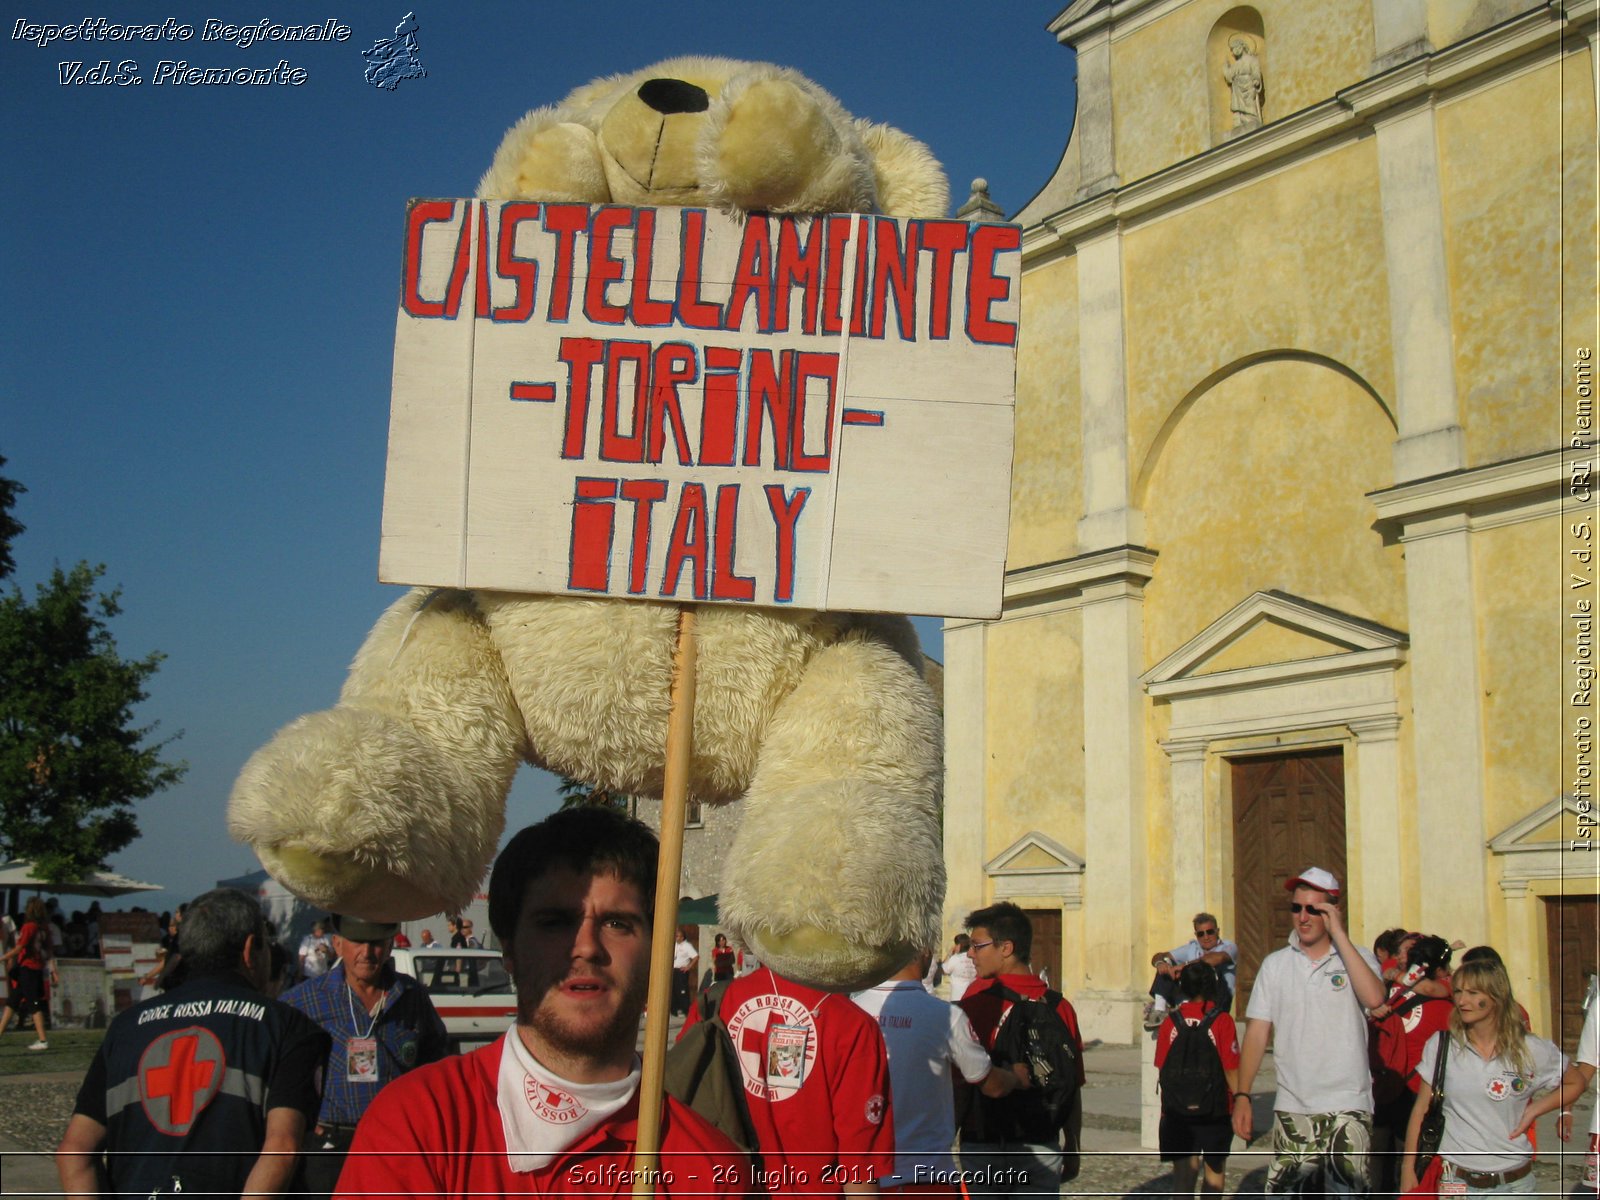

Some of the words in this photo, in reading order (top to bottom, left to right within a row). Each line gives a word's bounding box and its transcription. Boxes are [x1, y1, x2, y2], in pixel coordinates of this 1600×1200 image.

[401, 200, 1023, 346] CASTELLAMONTE
[138, 1004, 173, 1025] CROCE
[173, 1000, 212, 1018] ROSSA
[214, 999, 266, 1021] ITALIANA
[756, 996, 793, 1010] ROSSA
[535, 1102, 578, 1121] ROSSA
